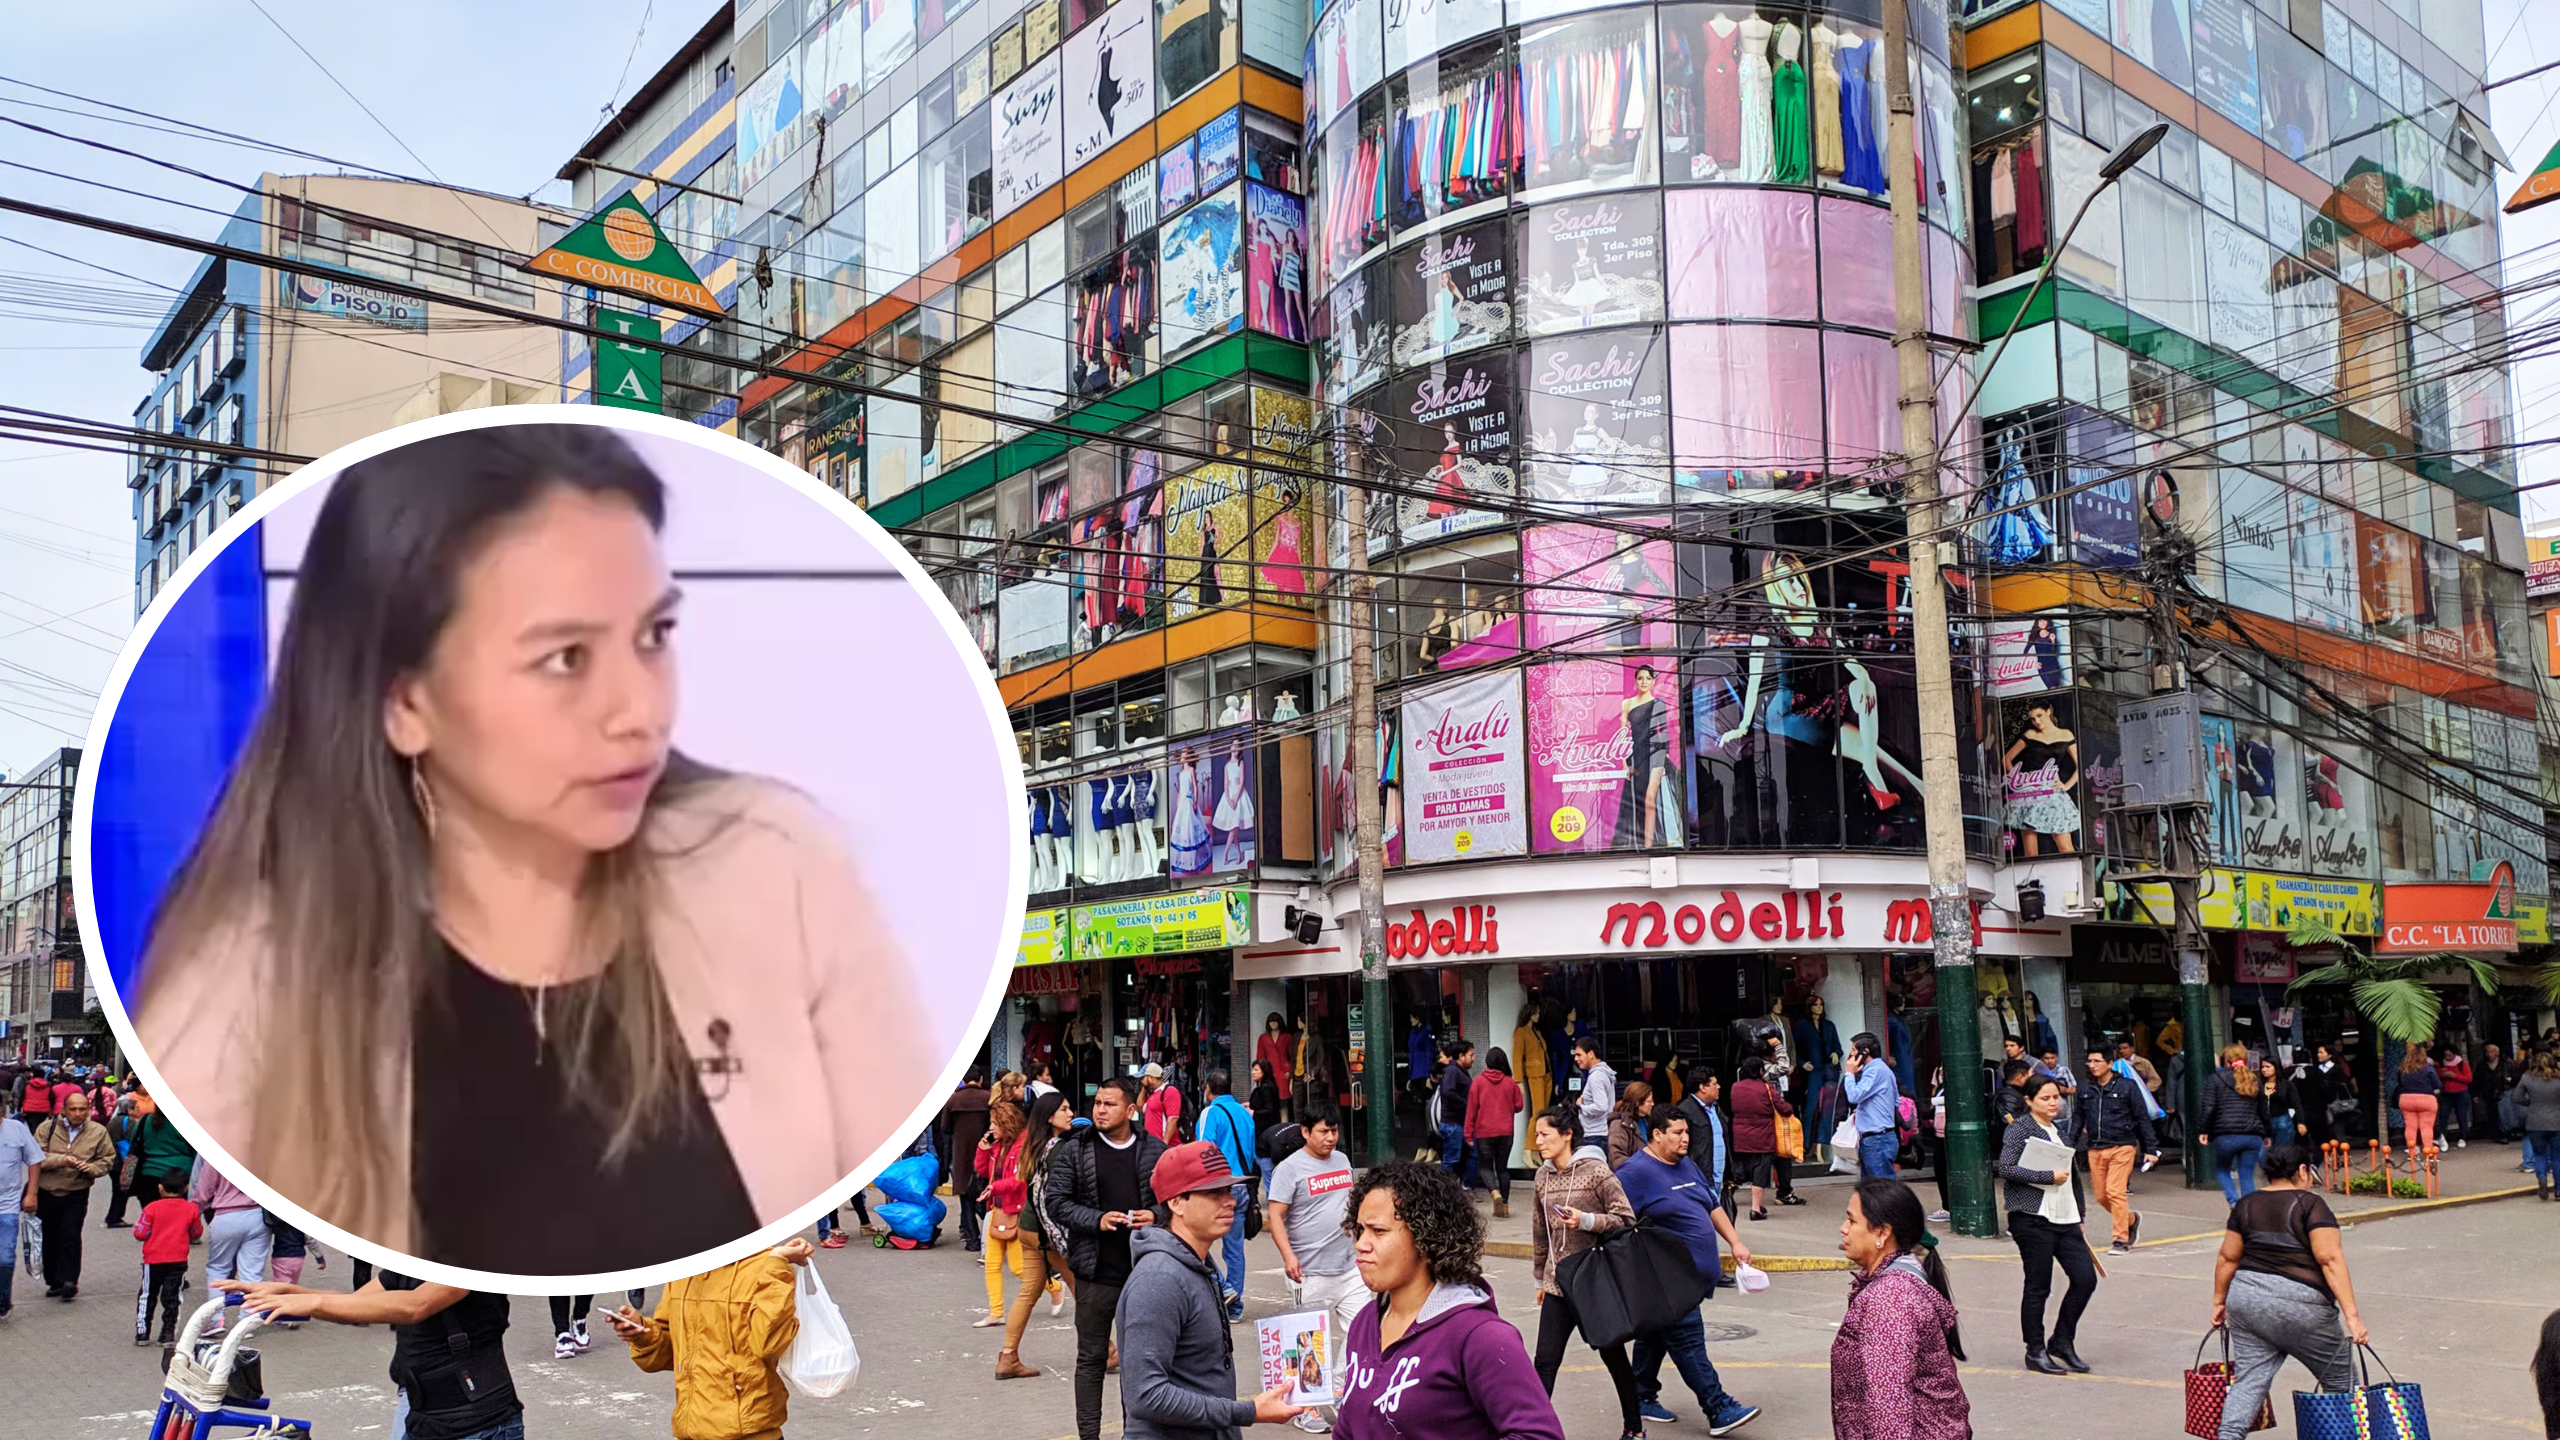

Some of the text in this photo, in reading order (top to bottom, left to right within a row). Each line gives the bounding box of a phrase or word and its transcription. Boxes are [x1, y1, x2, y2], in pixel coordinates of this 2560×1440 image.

[1124, 82, 1145, 108] 507
[1002, 83, 1056, 139] Susy
[1199, 110, 1238, 144] VESTIDOS
[1075, 130, 1102, 162] S-M
[997, 177, 1014, 194] 506
[1162, 159, 1193, 196] 408
[2530, 176, 2553, 195] C.
[1547, 202, 1622, 234] Sachi
[1554, 225, 1617, 242] COLLECTION
[1602, 235, 1654, 252] Tda. 309
[1415, 234, 1477, 273] Sachi
[1603, 249, 1653, 264] 3er Piso
[1420, 255, 1472, 280] COLLECTION
[548, 252, 708, 307] C. COMERCIAL
[331, 293, 408, 320] PISO 10
[1539, 345, 1641, 386] Sachi
[1411, 368, 1492, 414] Sachi
[1549, 377, 1633, 396] COLLECTION
[1418, 397, 1486, 424] COLLECTION
[1610, 394, 1662, 410] Tda. 309
[1611, 408, 1662, 421] 3er Piso
[1454, 517, 1468, 528] Zoe
[1415, 700, 1511, 756] Analú
[1438, 767, 1494, 783] Moda juvenil
[1422, 783, 1506, 803] VENTA DE VESTIDOS
[1435, 799, 1491, 816] PARA DAMAS
[1419, 812, 1511, 833] POR AMYOR Y MENOR
[1557, 822, 1581, 833] 209
[1456, 840, 1471, 848] 209
[1148, 899, 1154, 911] Y
[1154, 897, 1176, 910] CASA
[1177, 895, 1189, 906] DE
[1600, 891, 1844, 948] modelli
[2387, 925, 2429, 946] C.C.
[2468, 925, 2508, 946] TORRE
[1310, 1171, 1352, 1191] Supreme
[1260, 1326, 1270, 1344] LA
[1262, 1347, 1271, 1357] A
[1271, 1328, 1283, 1386] RASA
